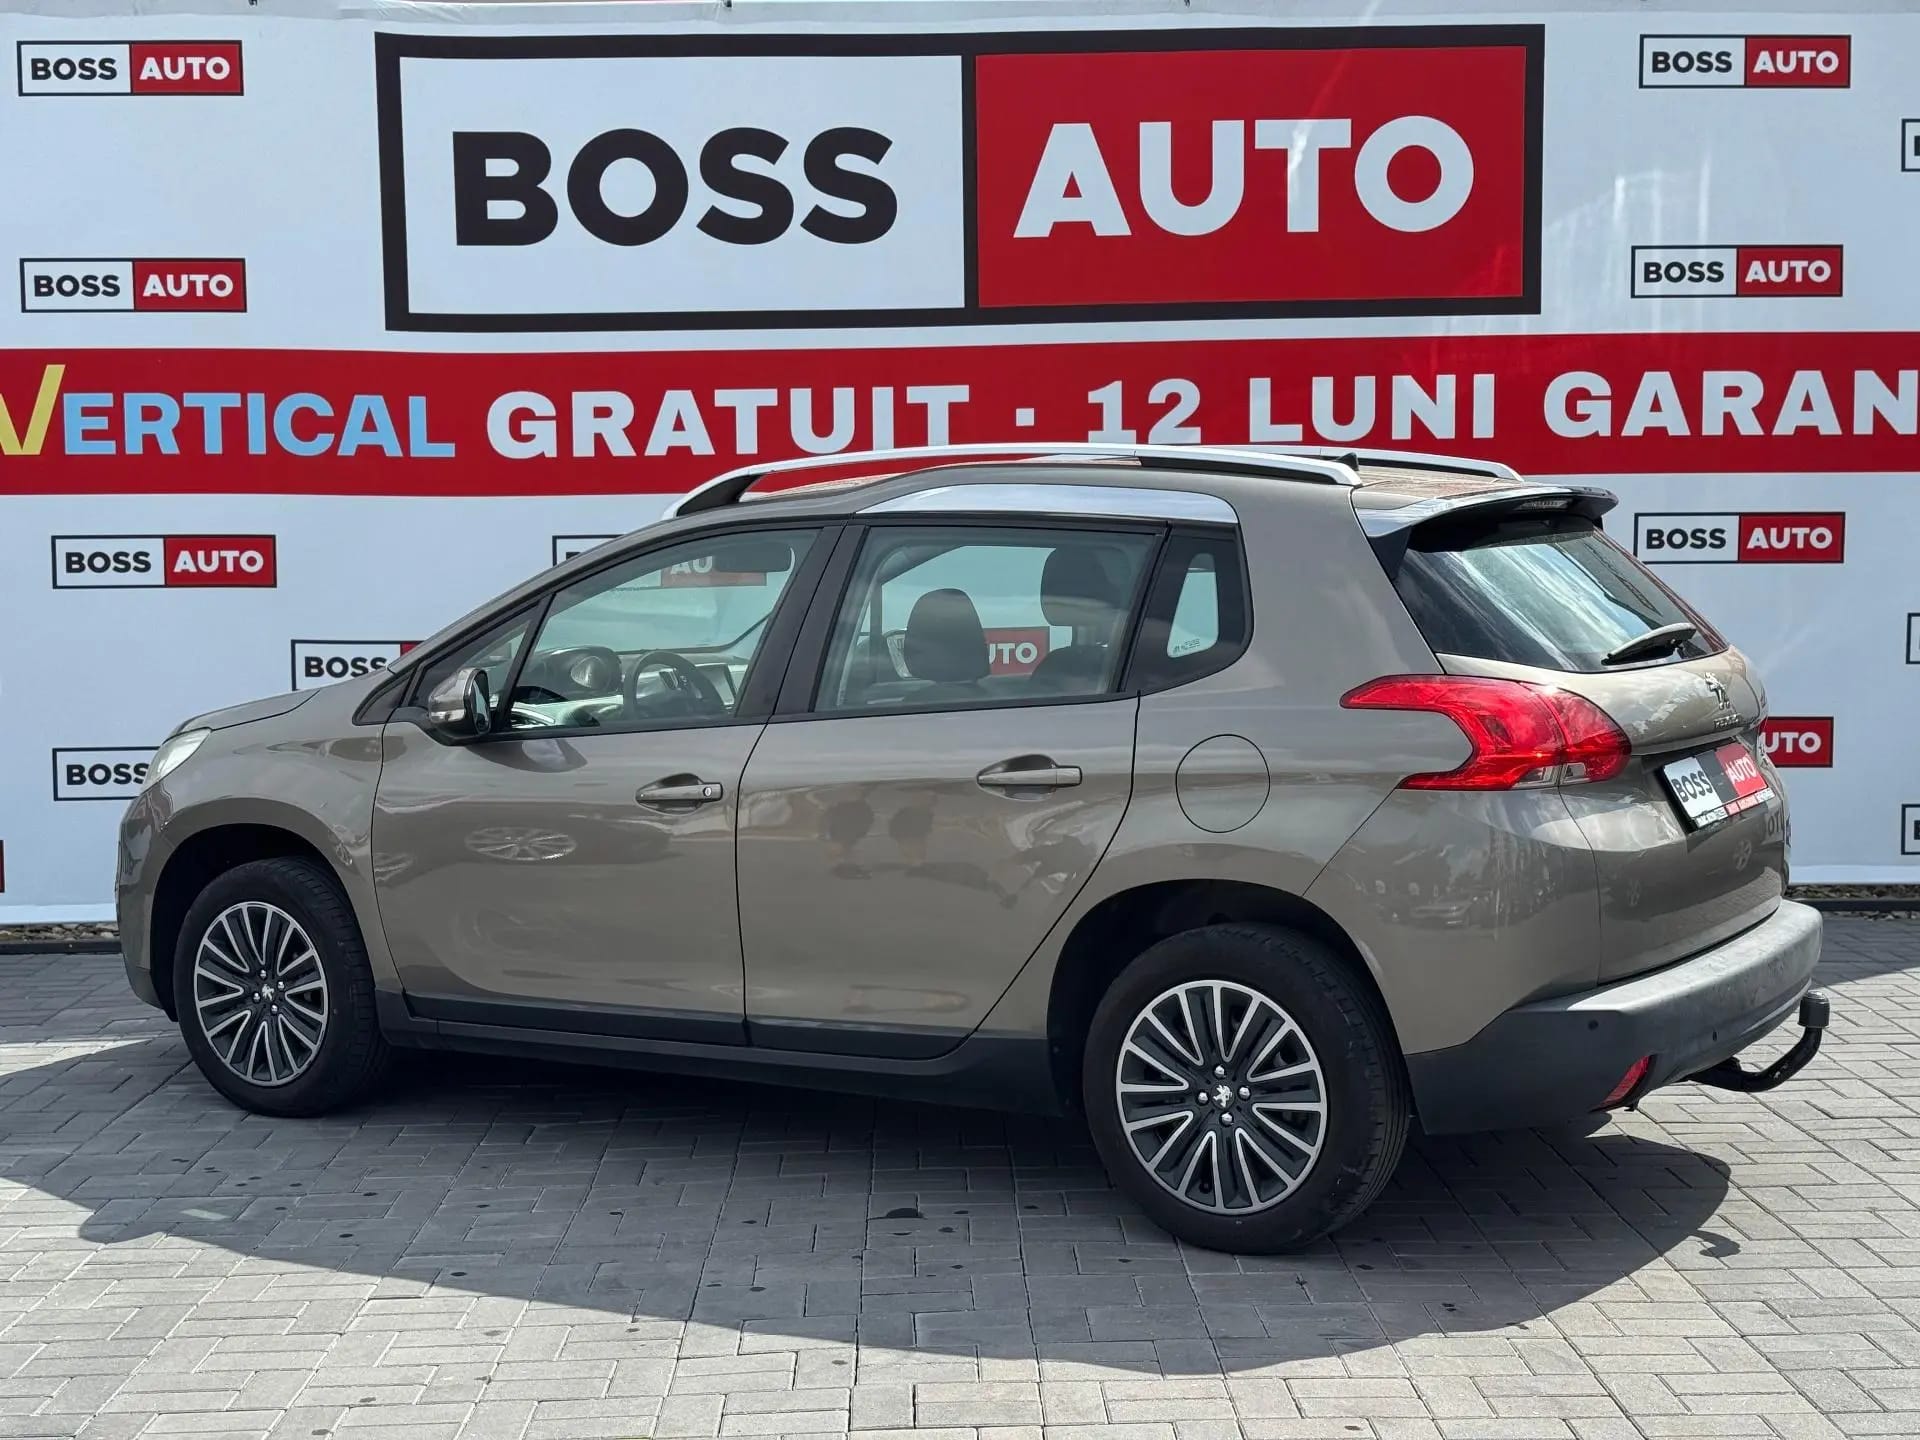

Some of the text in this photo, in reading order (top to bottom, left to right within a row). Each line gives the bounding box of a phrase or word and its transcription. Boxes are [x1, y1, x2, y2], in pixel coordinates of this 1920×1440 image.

[31, 57, 231, 81] BOSS AUTO
[1651, 50, 1839, 74] BOSS AUTO
[452, 115, 1475, 247] BOSS AUTO
[1643, 260, 1831, 284] BOSS AUTO
[34, 274, 234, 297] BOSS AUTO
[0, 364, 1919, 459] VERTICAL GRATUIT 12 LUNI GARAN
[1645, 526, 1833, 550] BOSS AUTO
[65, 549, 264, 573] BOSS AUTO
[66, 762, 150, 786] BOSS
[1670, 752, 1758, 803] BOSS AUTO
